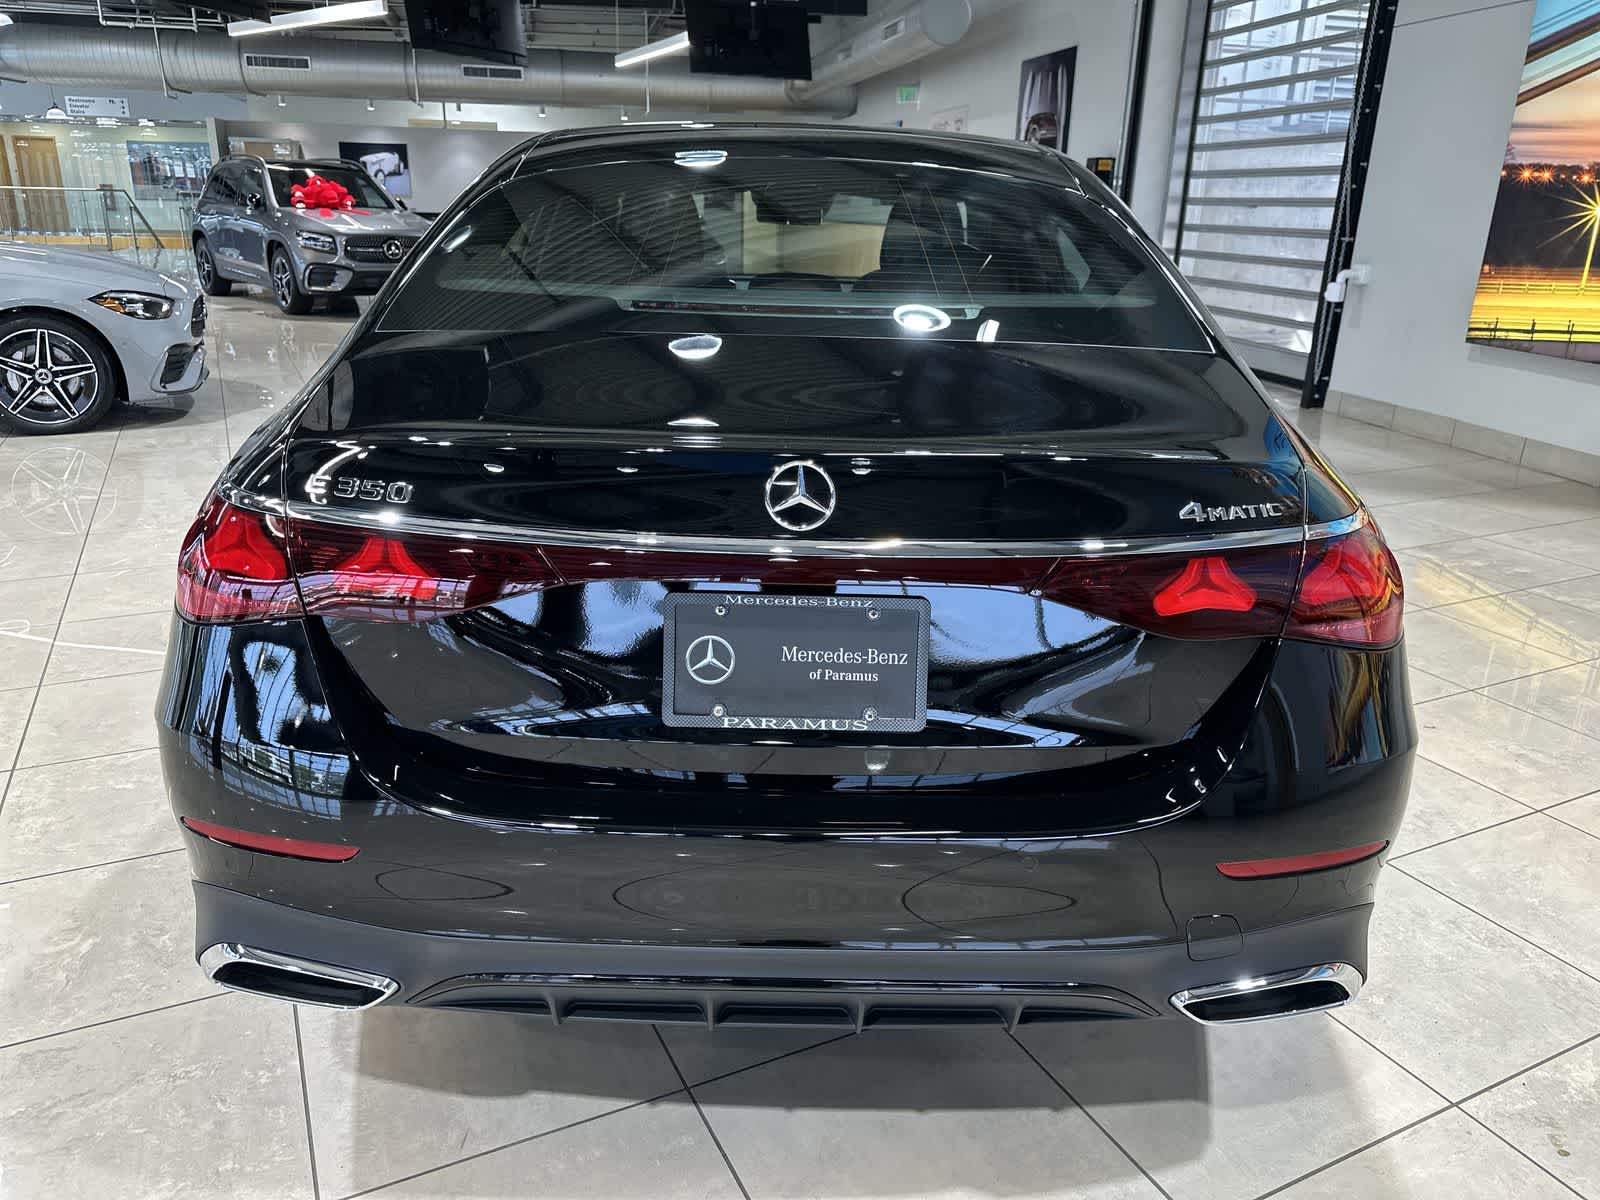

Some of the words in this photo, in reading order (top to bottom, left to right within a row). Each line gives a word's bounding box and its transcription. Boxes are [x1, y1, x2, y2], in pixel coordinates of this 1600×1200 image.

[305, 473, 332, 494] E
[334, 476, 414, 504] 350
[1178, 500, 1285, 522] 4MATIC
[724, 594, 874, 608] Mercedes-Benz
[781, 646, 909, 666] Mercedes-Benz
[809, 669, 823, 681] of
[824, 669, 879, 682] Paramus
[721, 717, 869, 731] PARAMUS
